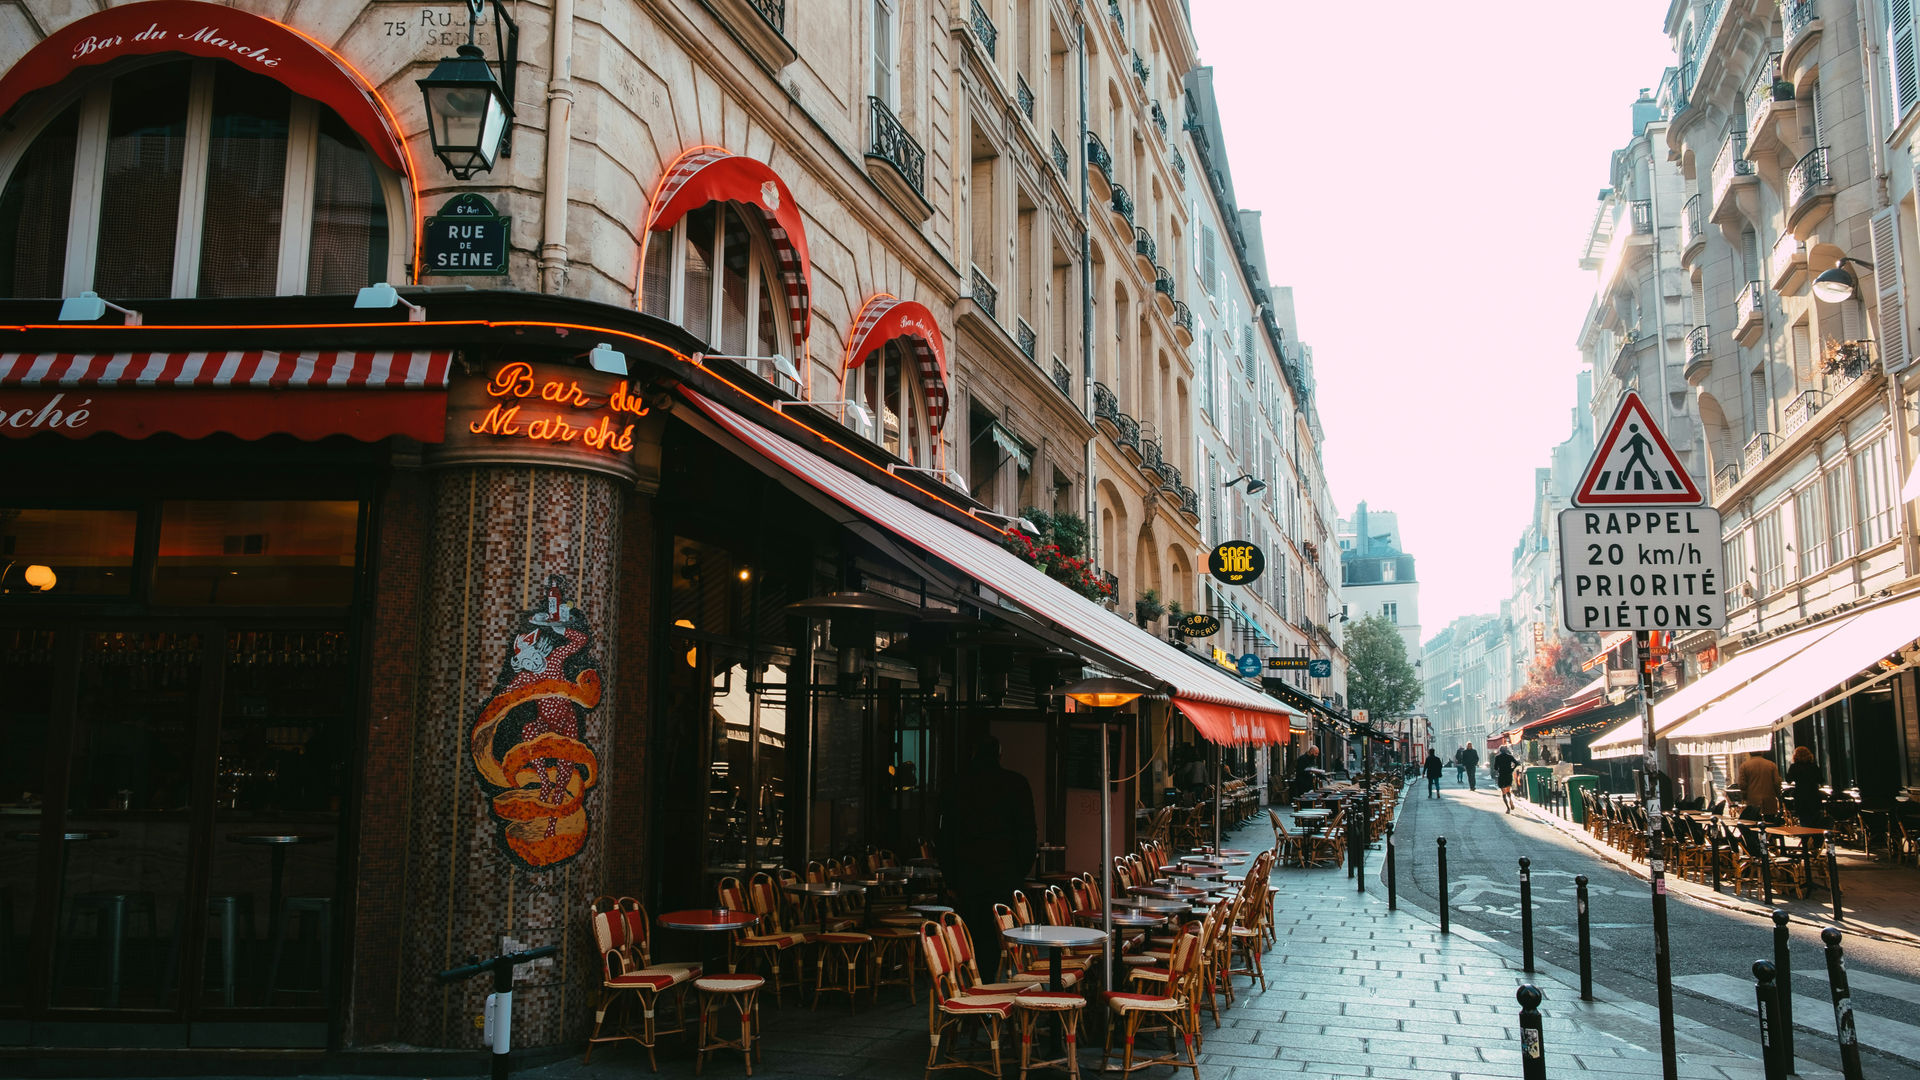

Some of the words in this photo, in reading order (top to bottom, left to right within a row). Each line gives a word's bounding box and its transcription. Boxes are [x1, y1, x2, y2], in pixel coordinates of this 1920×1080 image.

[384, 21, 406, 37] 75
[72, 35, 123, 60] Bar
[131, 23, 168, 42] du
[178, 26, 282, 68] Marché
[651, 91, 660, 109] 16
[448, 225, 485, 239] RUE
[459, 242, 472, 250] DE
[437, 252, 493, 267] SEINE
[486, 361, 590, 407] Bar
[610, 380, 650, 416] du
[469, 403, 636, 452] Marché
[1585, 512, 1700, 534] RAPPEL
[1587, 543, 1624, 565] 20
[1638, 543, 1701, 565] km/h
[1576, 568, 1716, 596] PRIORITÉ
[1584, 601, 1712, 628] PIÉTONS
